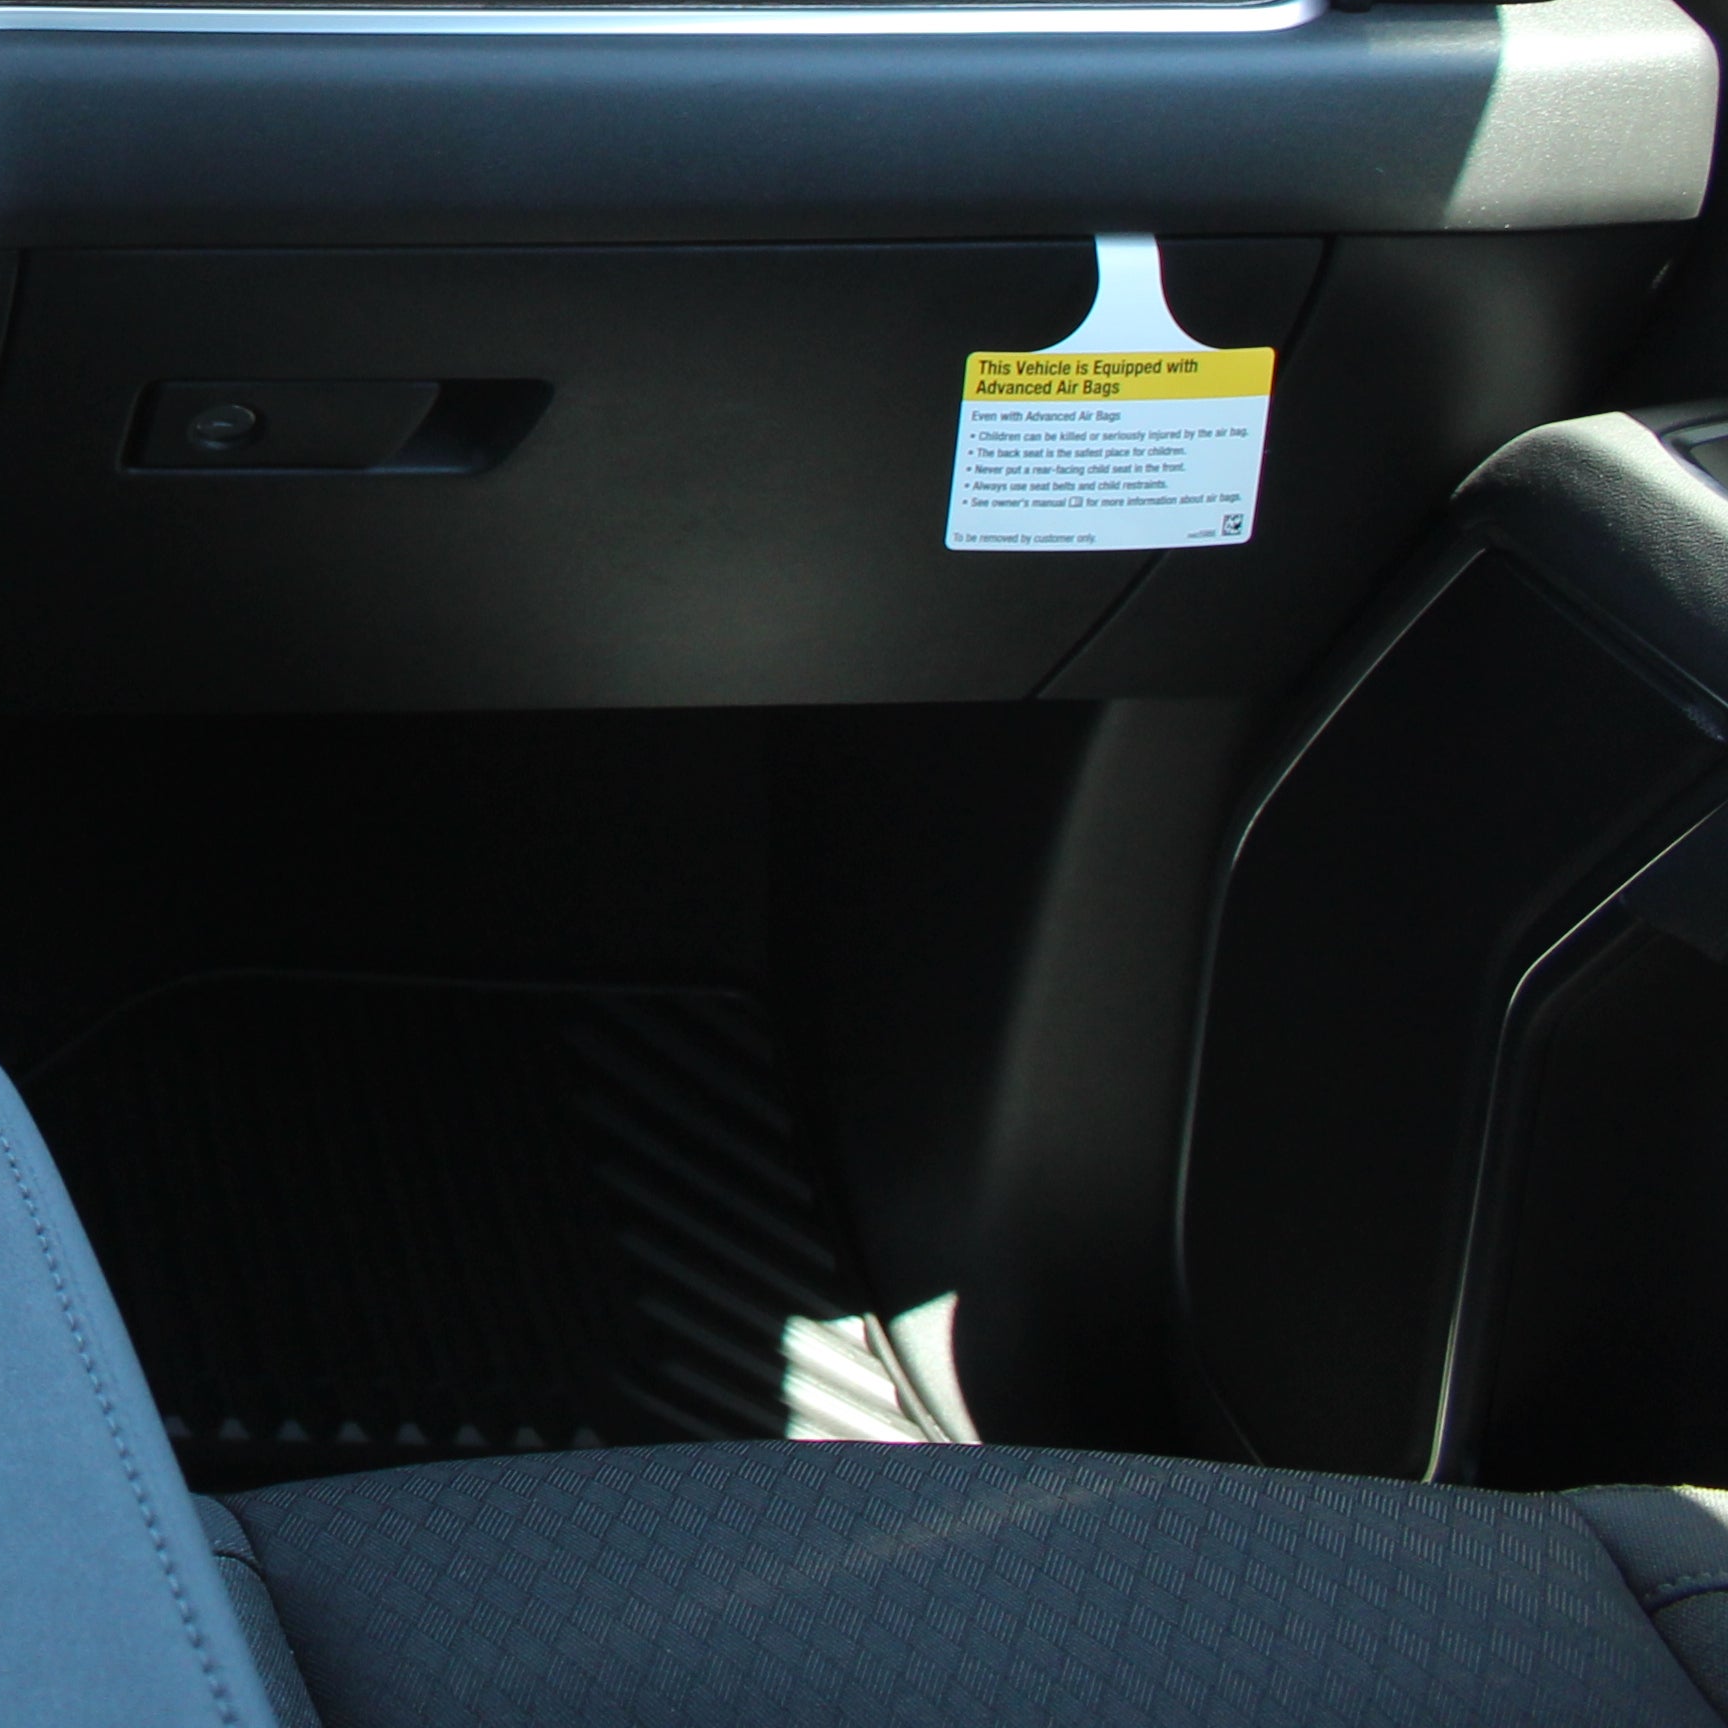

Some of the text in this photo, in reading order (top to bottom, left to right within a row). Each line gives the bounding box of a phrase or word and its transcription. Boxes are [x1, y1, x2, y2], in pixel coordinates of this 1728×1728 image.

[980, 359, 1198, 377] This Vehicle is Equipped with
[976, 380, 1120, 397] Advanced Air Bags
[972, 410, 1121, 422] Even with Advanced Air Bags
[979, 432, 1021, 440] Children
[1045, 432, 1056, 440] be
[1060, 432, 1086, 440] killed
[1102, 432, 1145, 441] seriously
[1148, 430, 1181, 441] injured
[1184, 430, 1195, 440] by
[1198, 429, 1212, 438] the
[1215, 428, 1226, 437] air
[977, 448, 994, 457] The
[998, 448, 1019, 457] back
[1023, 449, 1043, 457] seat
[1046, 448, 1054, 457] is
[1057, 448, 1072, 457] the
[1074, 449, 1102, 457] safest
[1105, 448, 1130, 458] place
[1133, 448, 1145, 456] for
[974, 465, 1003, 474] Never
[1005, 465, 1021, 475] put
[1033, 466, 1084, 475] rear-facing
[1088, 465, 1109, 473] child
[1112, 465, 1131, 473] seat
[1146, 464, 1159, 472] the
[973, 482, 1007, 492] Always
[1030, 482, 1050, 490] seat
[1052, 482, 1075, 490] belts
[1078, 482, 1096, 490] and
[1098, 481, 1120, 490] child
[971, 498, 988, 507] See
[992, 499, 1029, 507] owner's
[1032, 498, 1066, 507] manual
[1086, 498, 1098, 506] for
[1101, 498, 1124, 506] more
[1127, 496, 1177, 505] information
[1179, 495, 1203, 504] about
[1206, 494, 1217, 502] air
[954, 533, 1096, 544] To be removed by customer only.
